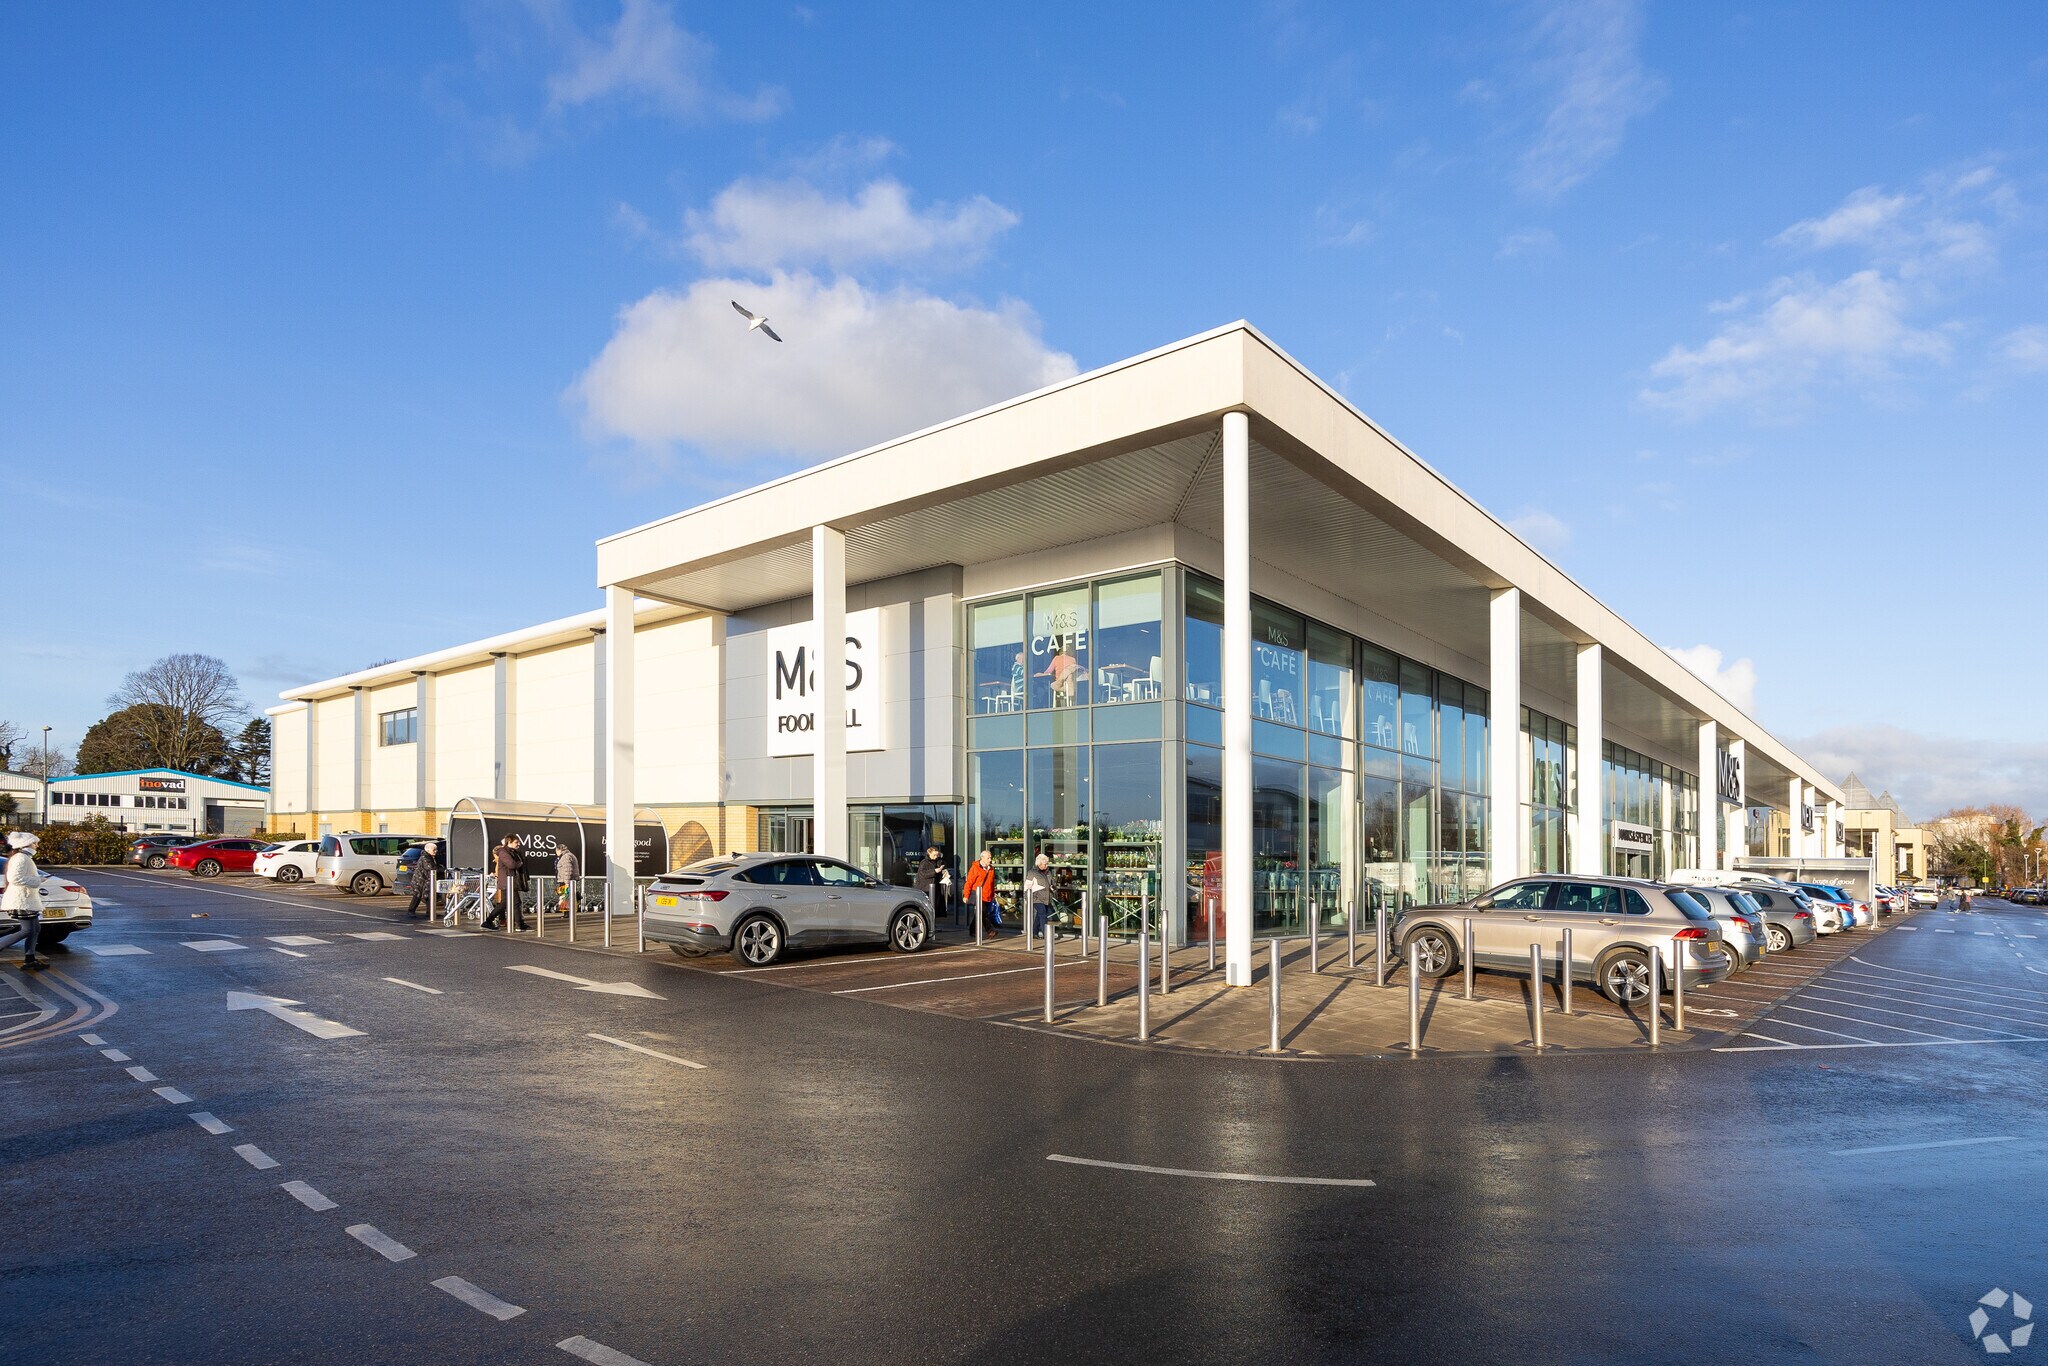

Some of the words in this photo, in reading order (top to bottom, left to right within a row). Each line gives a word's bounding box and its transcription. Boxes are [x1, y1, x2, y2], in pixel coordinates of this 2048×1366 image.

[1043, 608, 1078, 630] M&S
[1268, 625, 1289, 647] M&S
[776, 636, 862, 700] MS
[1260, 646, 1296, 676] CAFÉ
[140, 778, 185, 789] inovad
[1717, 747, 1741, 800] M&S
[515, 833, 557, 850] M&S
[525, 850, 549, 858] FOOD
[1837, 878, 1856, 887] good
